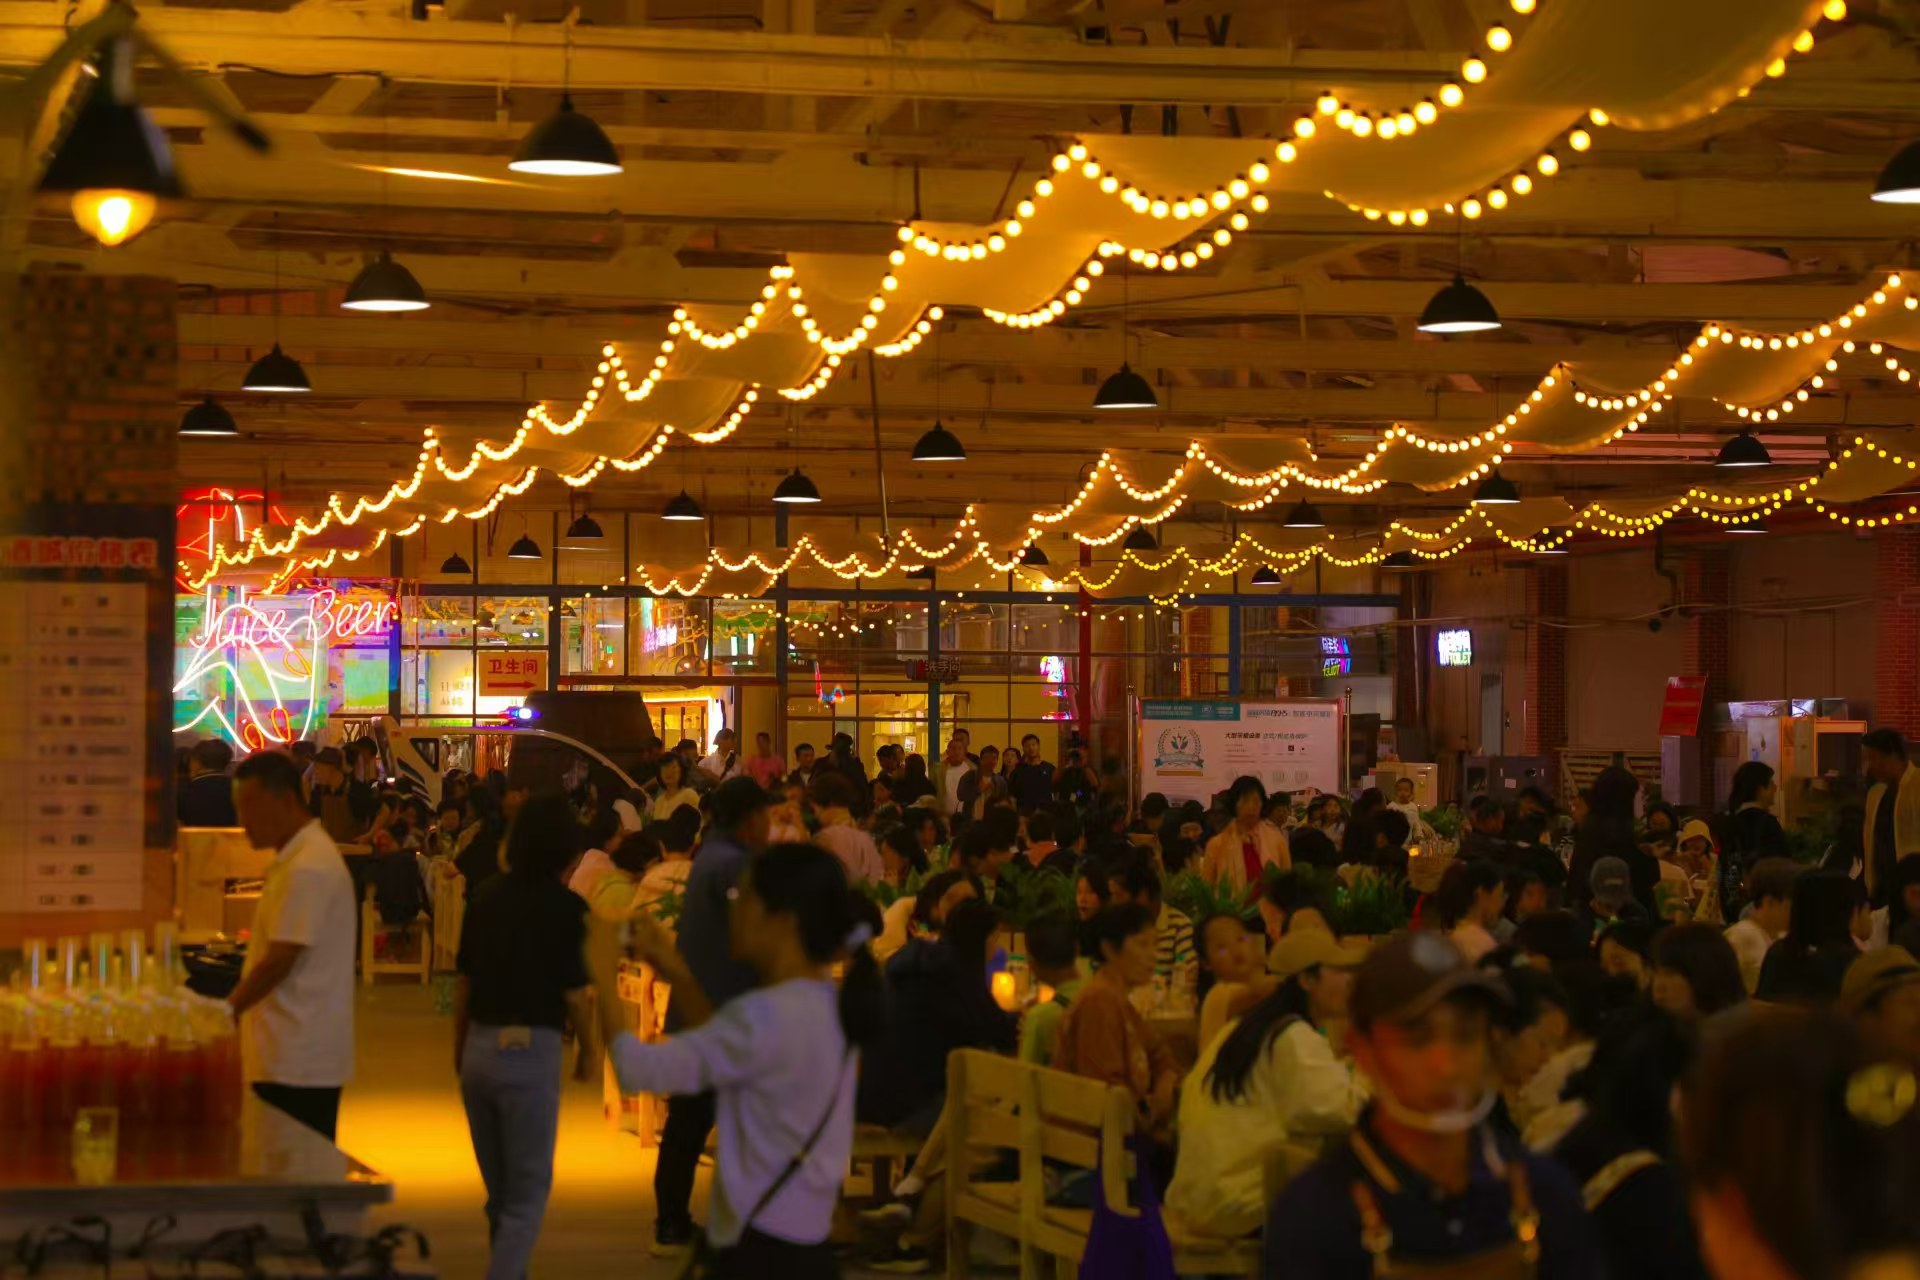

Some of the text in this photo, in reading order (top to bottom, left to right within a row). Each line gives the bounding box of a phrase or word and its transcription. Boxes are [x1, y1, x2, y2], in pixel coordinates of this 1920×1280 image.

[189, 589, 398, 649] Juice Beer
[488, 659, 538, 675] 卫生间
